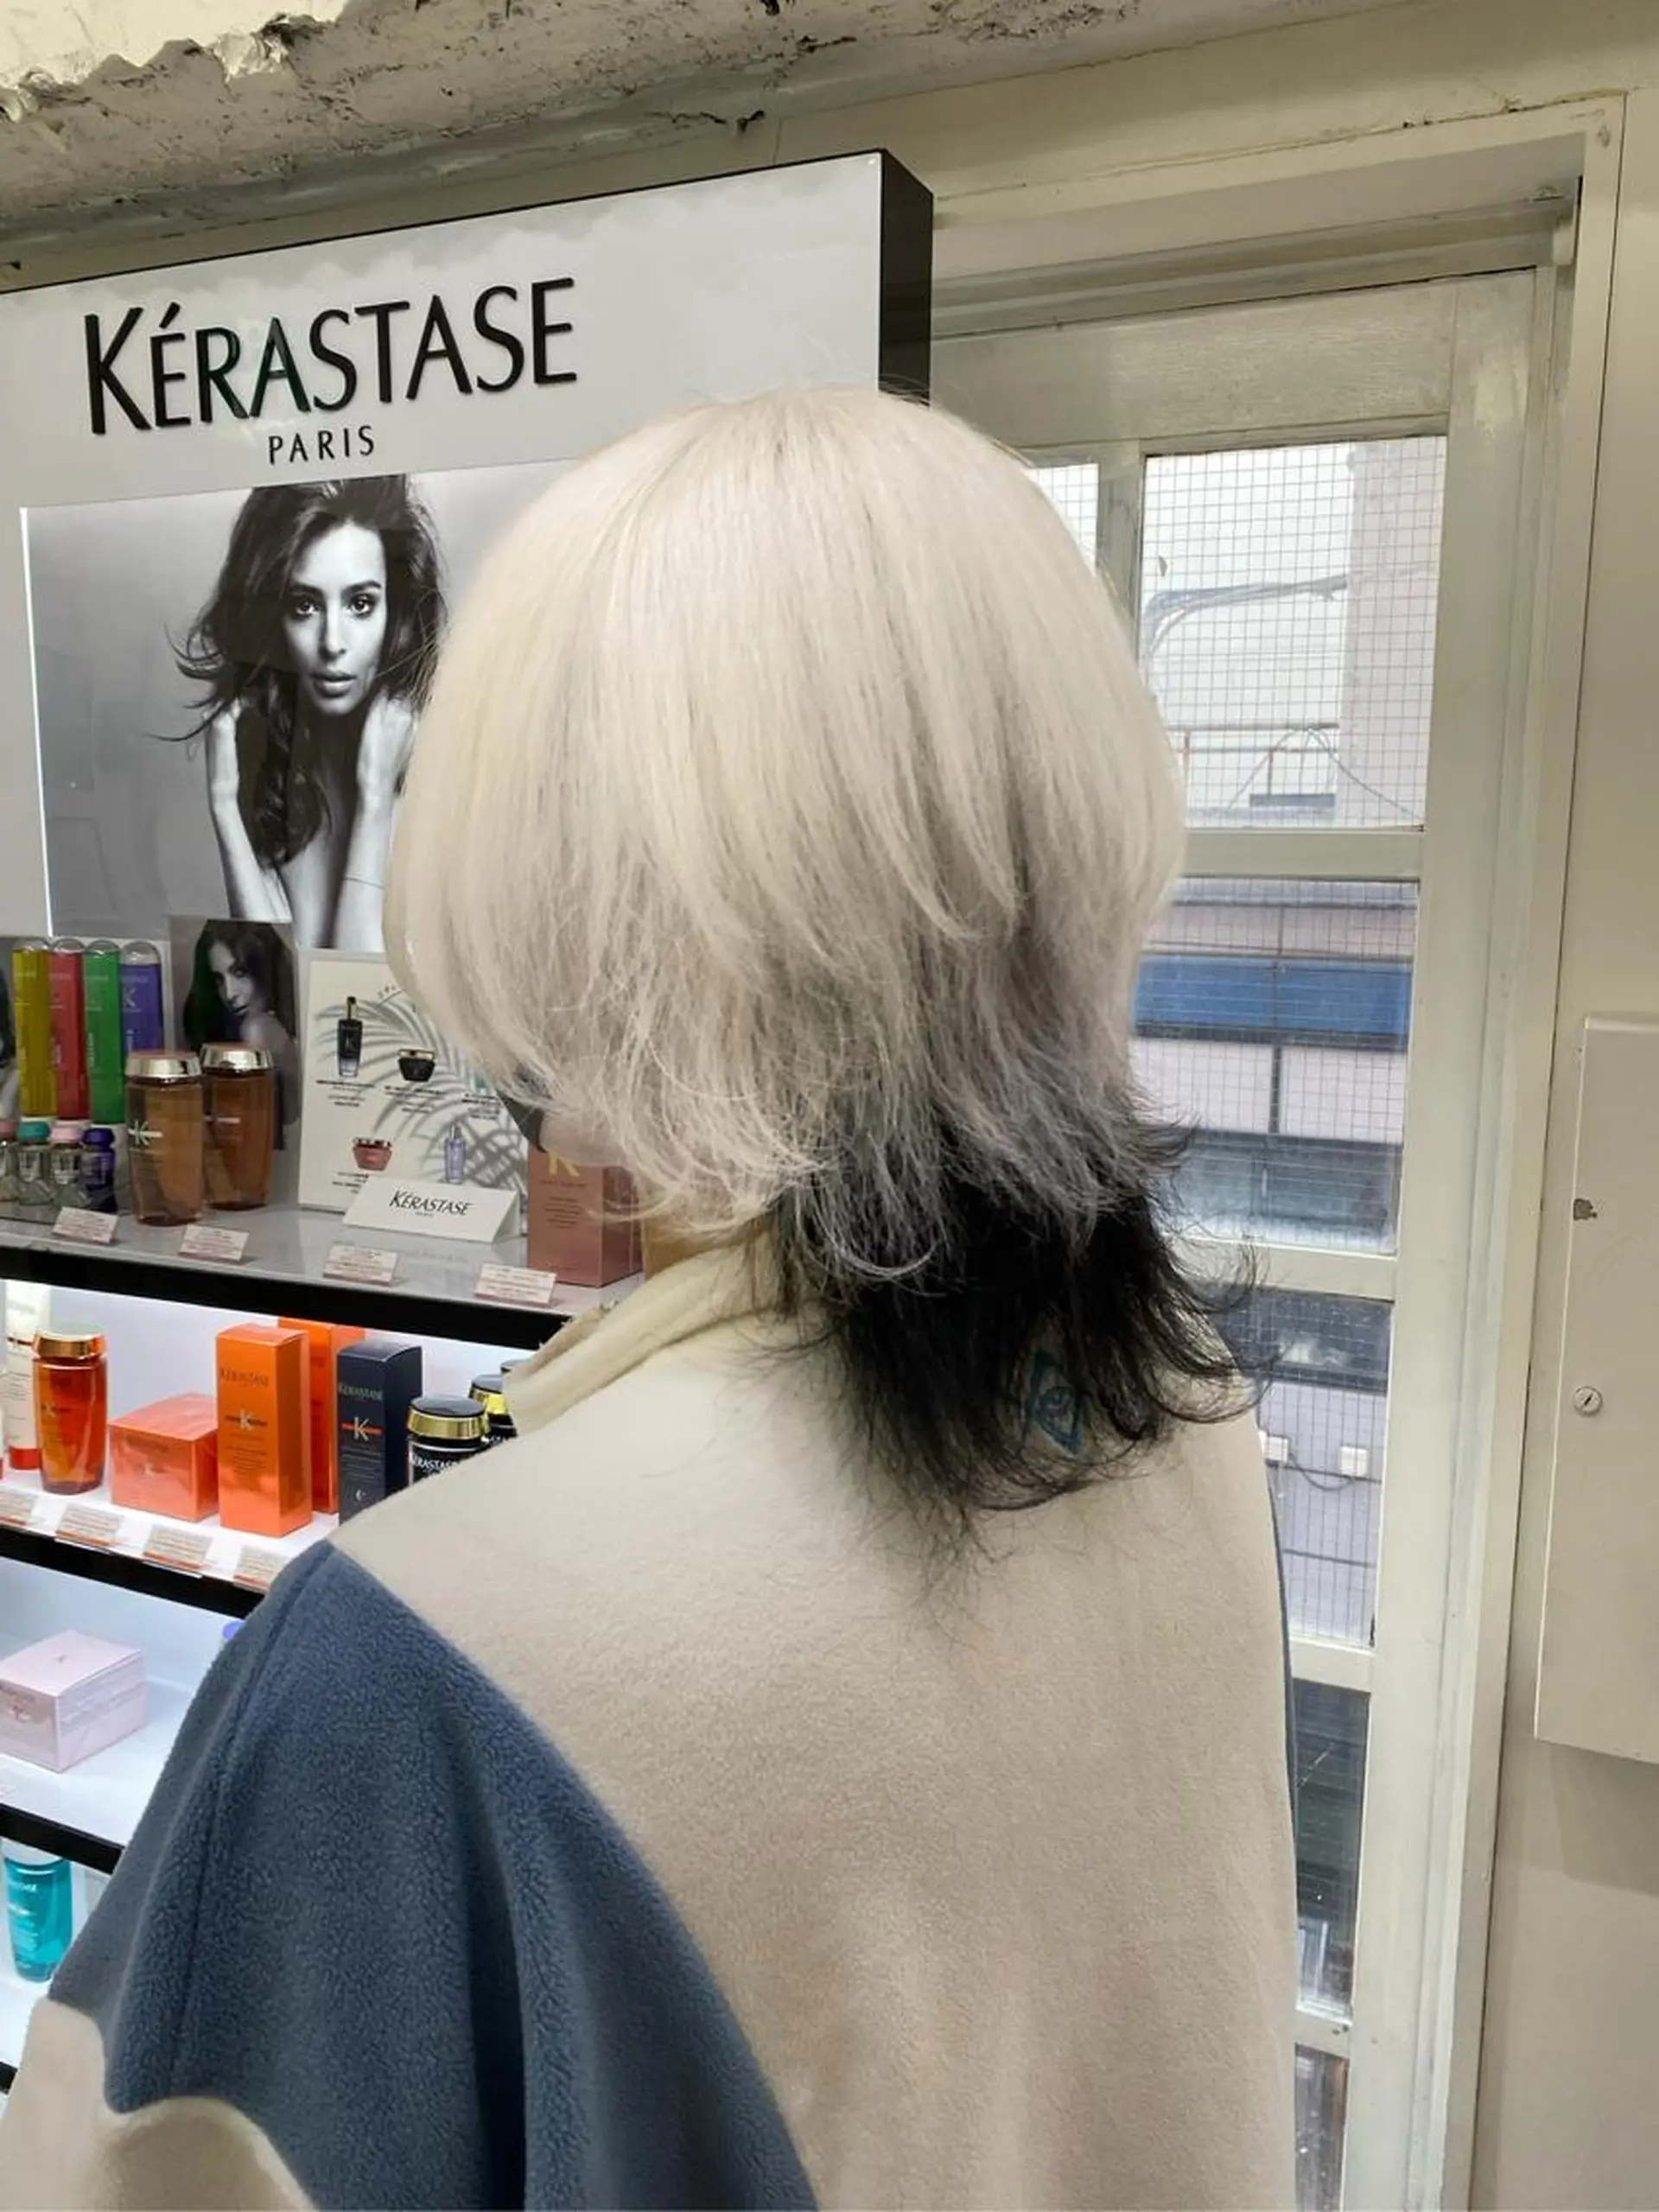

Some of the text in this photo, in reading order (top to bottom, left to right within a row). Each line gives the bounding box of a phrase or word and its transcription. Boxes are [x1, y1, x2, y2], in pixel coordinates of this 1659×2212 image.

[85, 276, 578, 435] KÉRASTASE
[269, 425, 375, 465] PARIS
[354, 1416, 369, 1441] K
